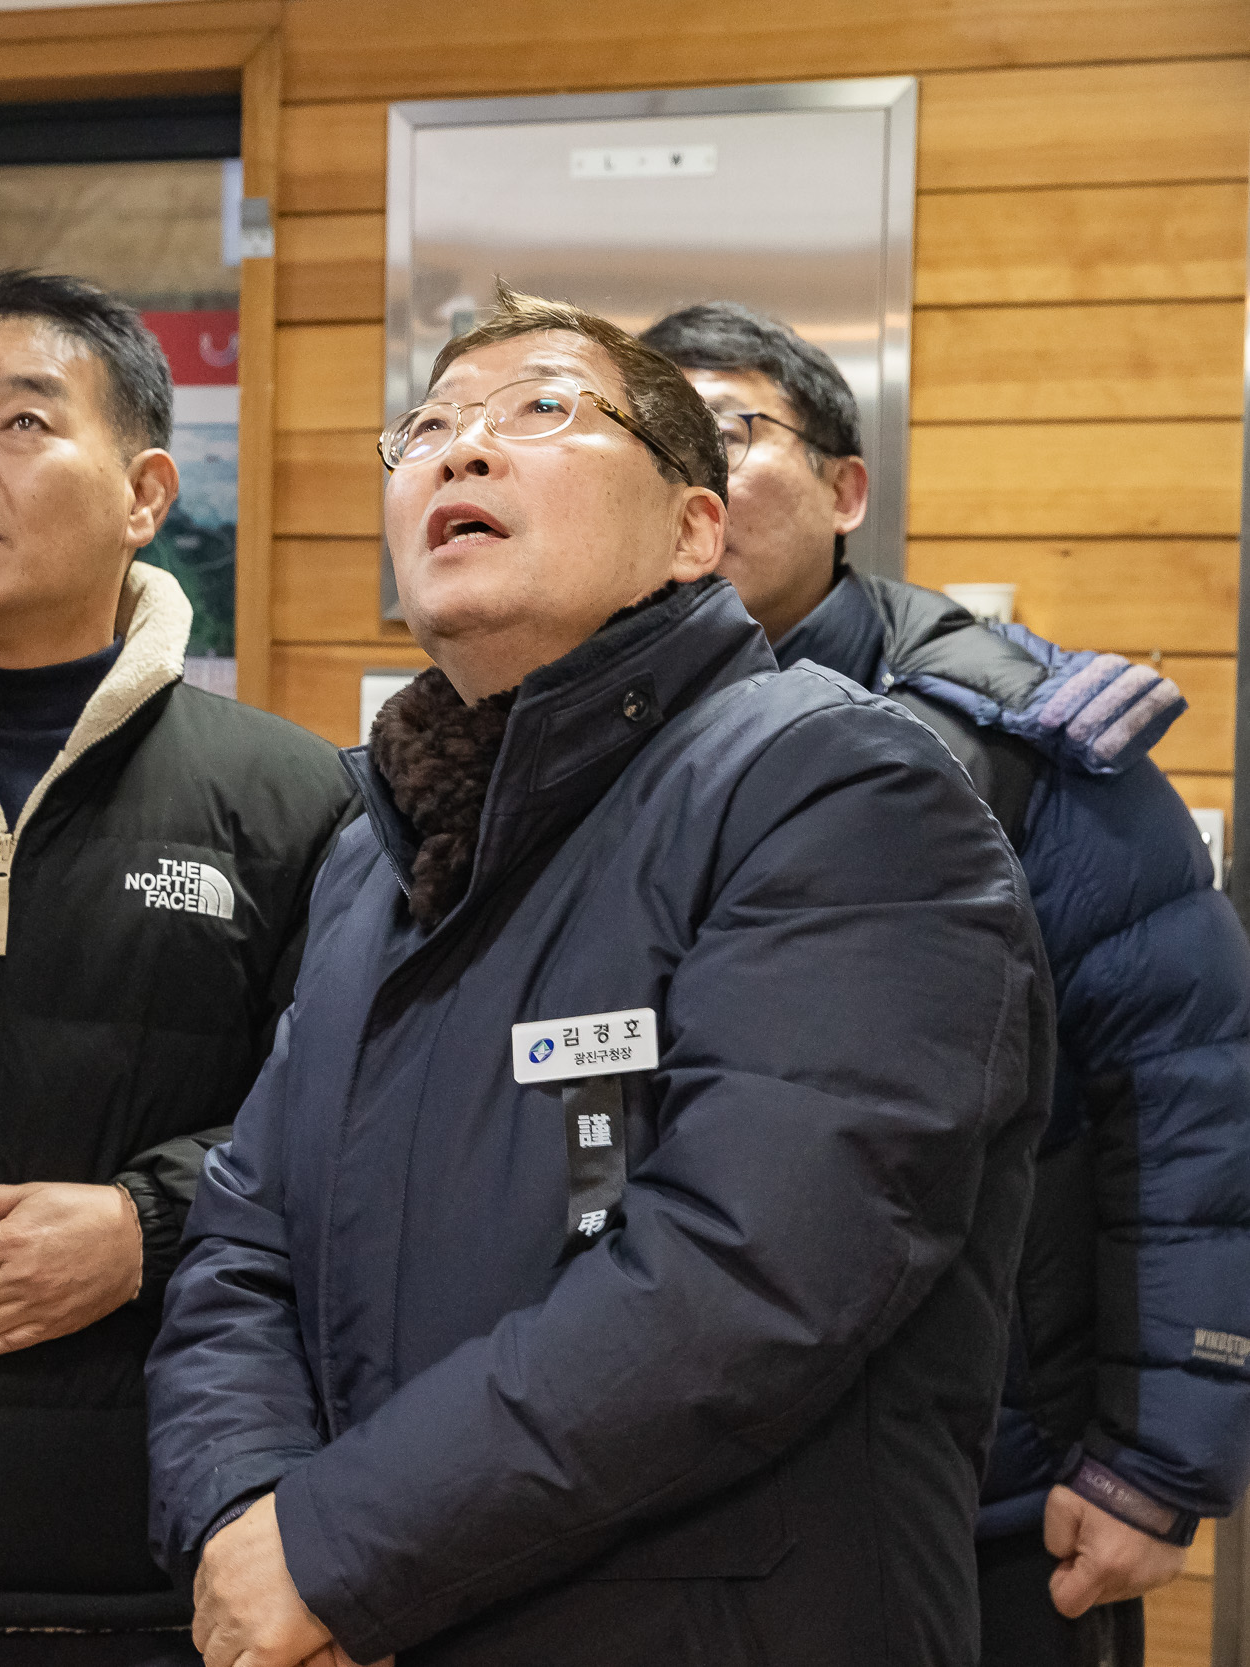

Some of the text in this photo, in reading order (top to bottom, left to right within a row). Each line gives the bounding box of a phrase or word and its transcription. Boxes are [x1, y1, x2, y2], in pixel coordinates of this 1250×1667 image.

[158, 858, 200, 879] THE
[125, 872, 200, 894] NORTH
[145, 889, 199, 913] FACE
[574, 1046, 633, 1067] 광진구청장
